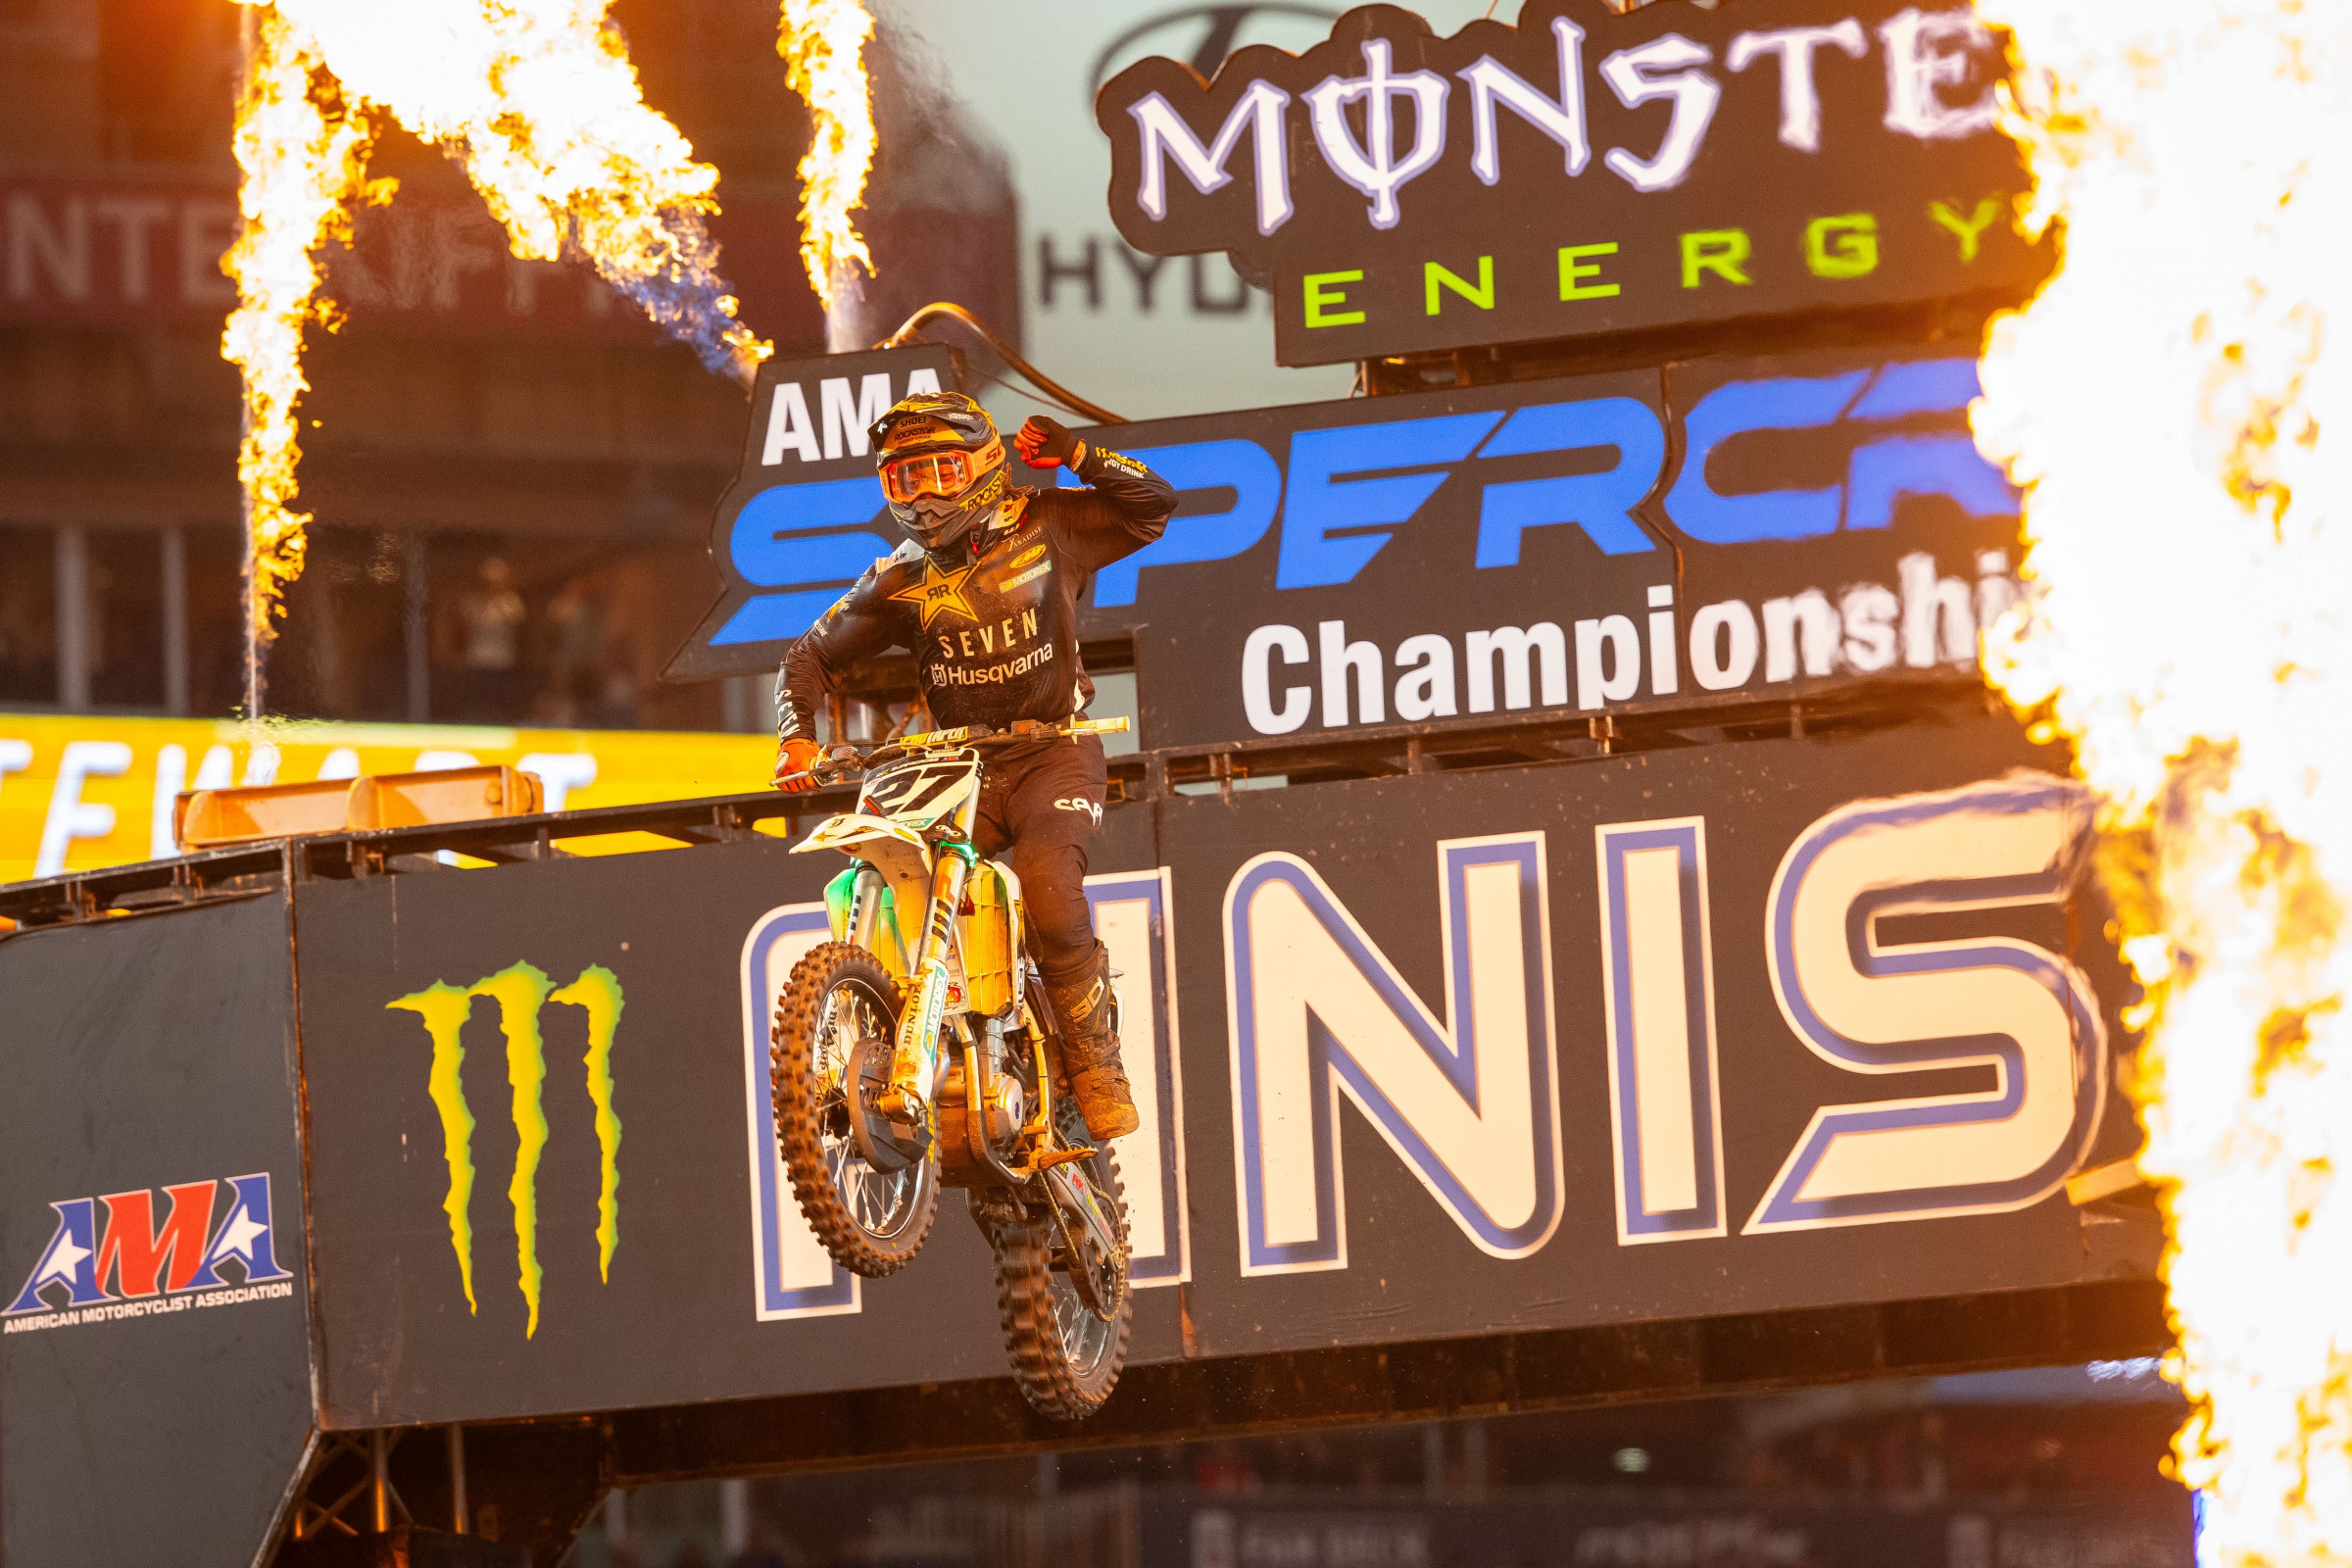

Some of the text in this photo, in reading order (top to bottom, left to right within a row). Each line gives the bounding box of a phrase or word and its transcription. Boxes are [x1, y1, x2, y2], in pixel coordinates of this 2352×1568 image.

[1302, 193, 2003, 328] ENERGY
[760, 368, 943, 467] AM
[894, 426, 936, 442] ROCKSTAR
[899, 416, 927, 429] SHOEI
[1121, 465, 1145, 478] DRINK
[1001, 525, 1043, 552] PARADISE
[1012, 562, 1051, 586] MOTOREX
[939, 609, 1038, 659] SEVEN
[948, 643, 1054, 685] Husqvarna
[860, 765, 973, 819] 27
[926, 971, 946, 1035] MOTOREX
[0, 1172, 294, 1317] AMA
[3, 1282, 293, 1335] AMERICAN MOTORCYCLIST ASSOCIATION
